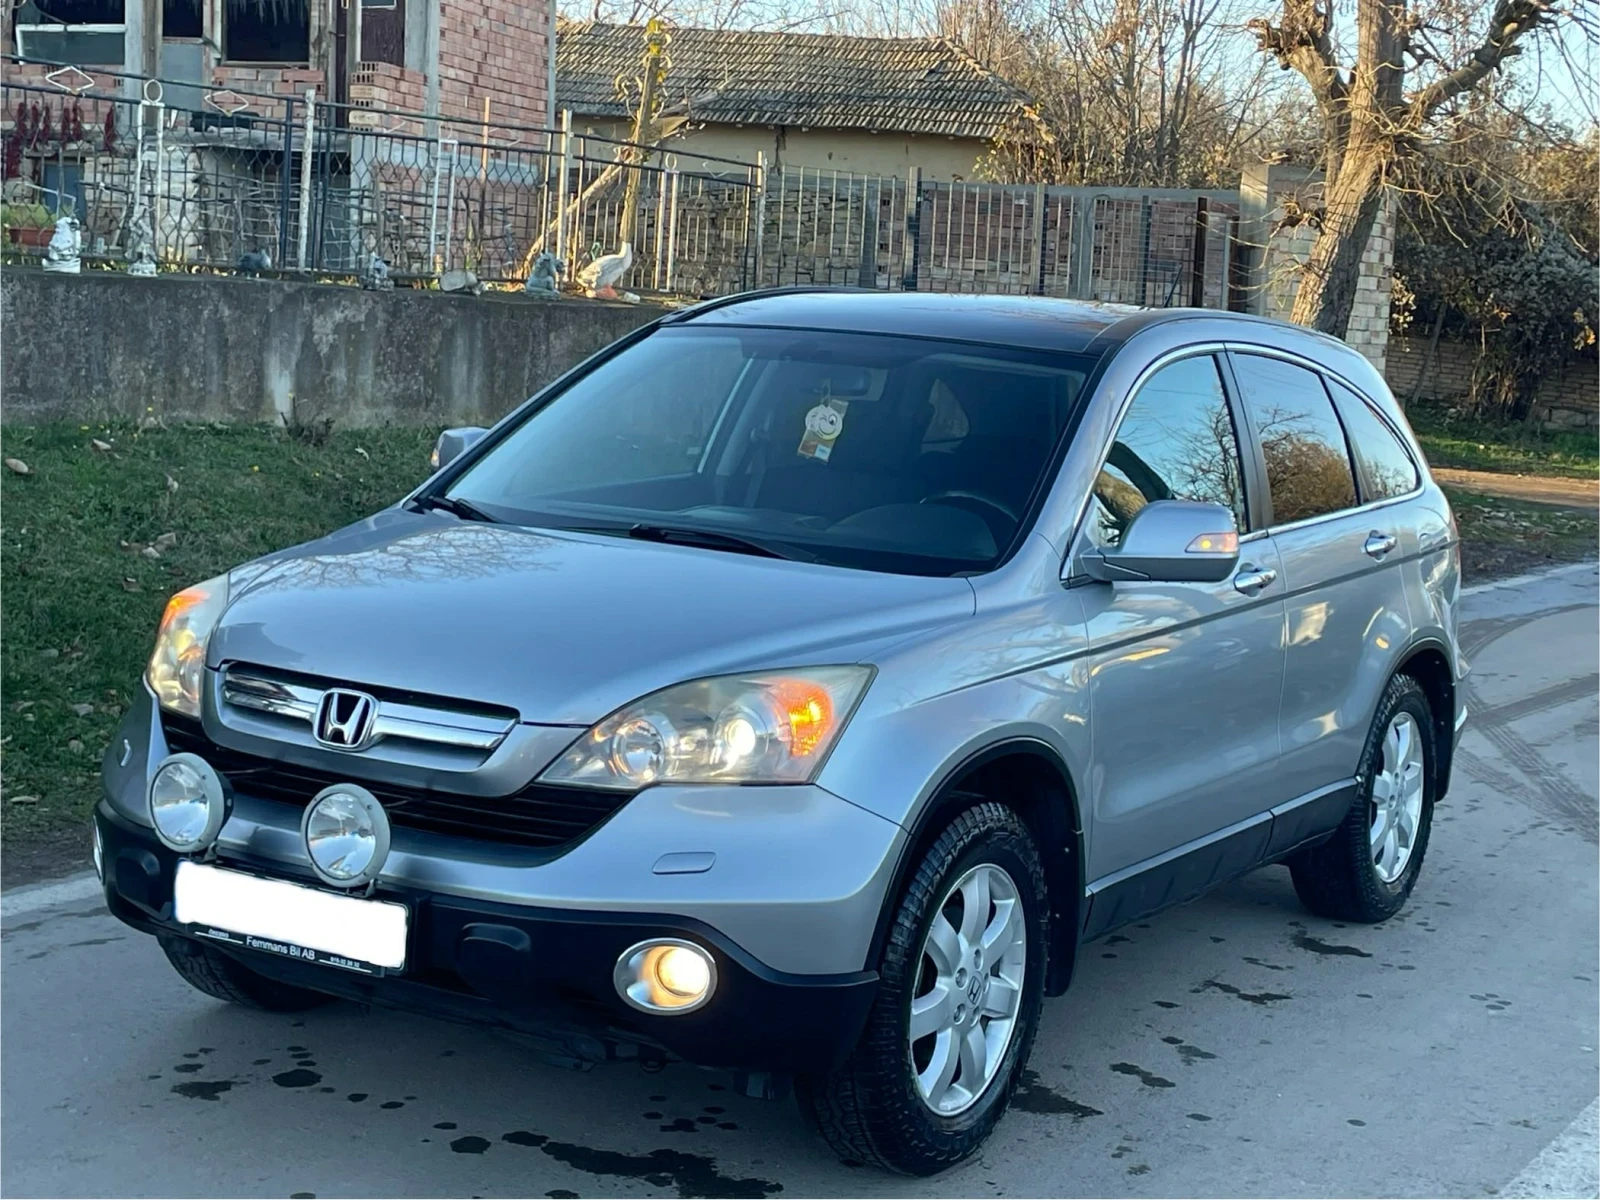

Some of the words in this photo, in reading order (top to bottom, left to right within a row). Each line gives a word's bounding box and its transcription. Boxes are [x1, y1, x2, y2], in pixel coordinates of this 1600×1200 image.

[246, 936, 288, 955] Femmans
[289, 945, 300, 956] Bil
[301, 947, 315, 960] AB
